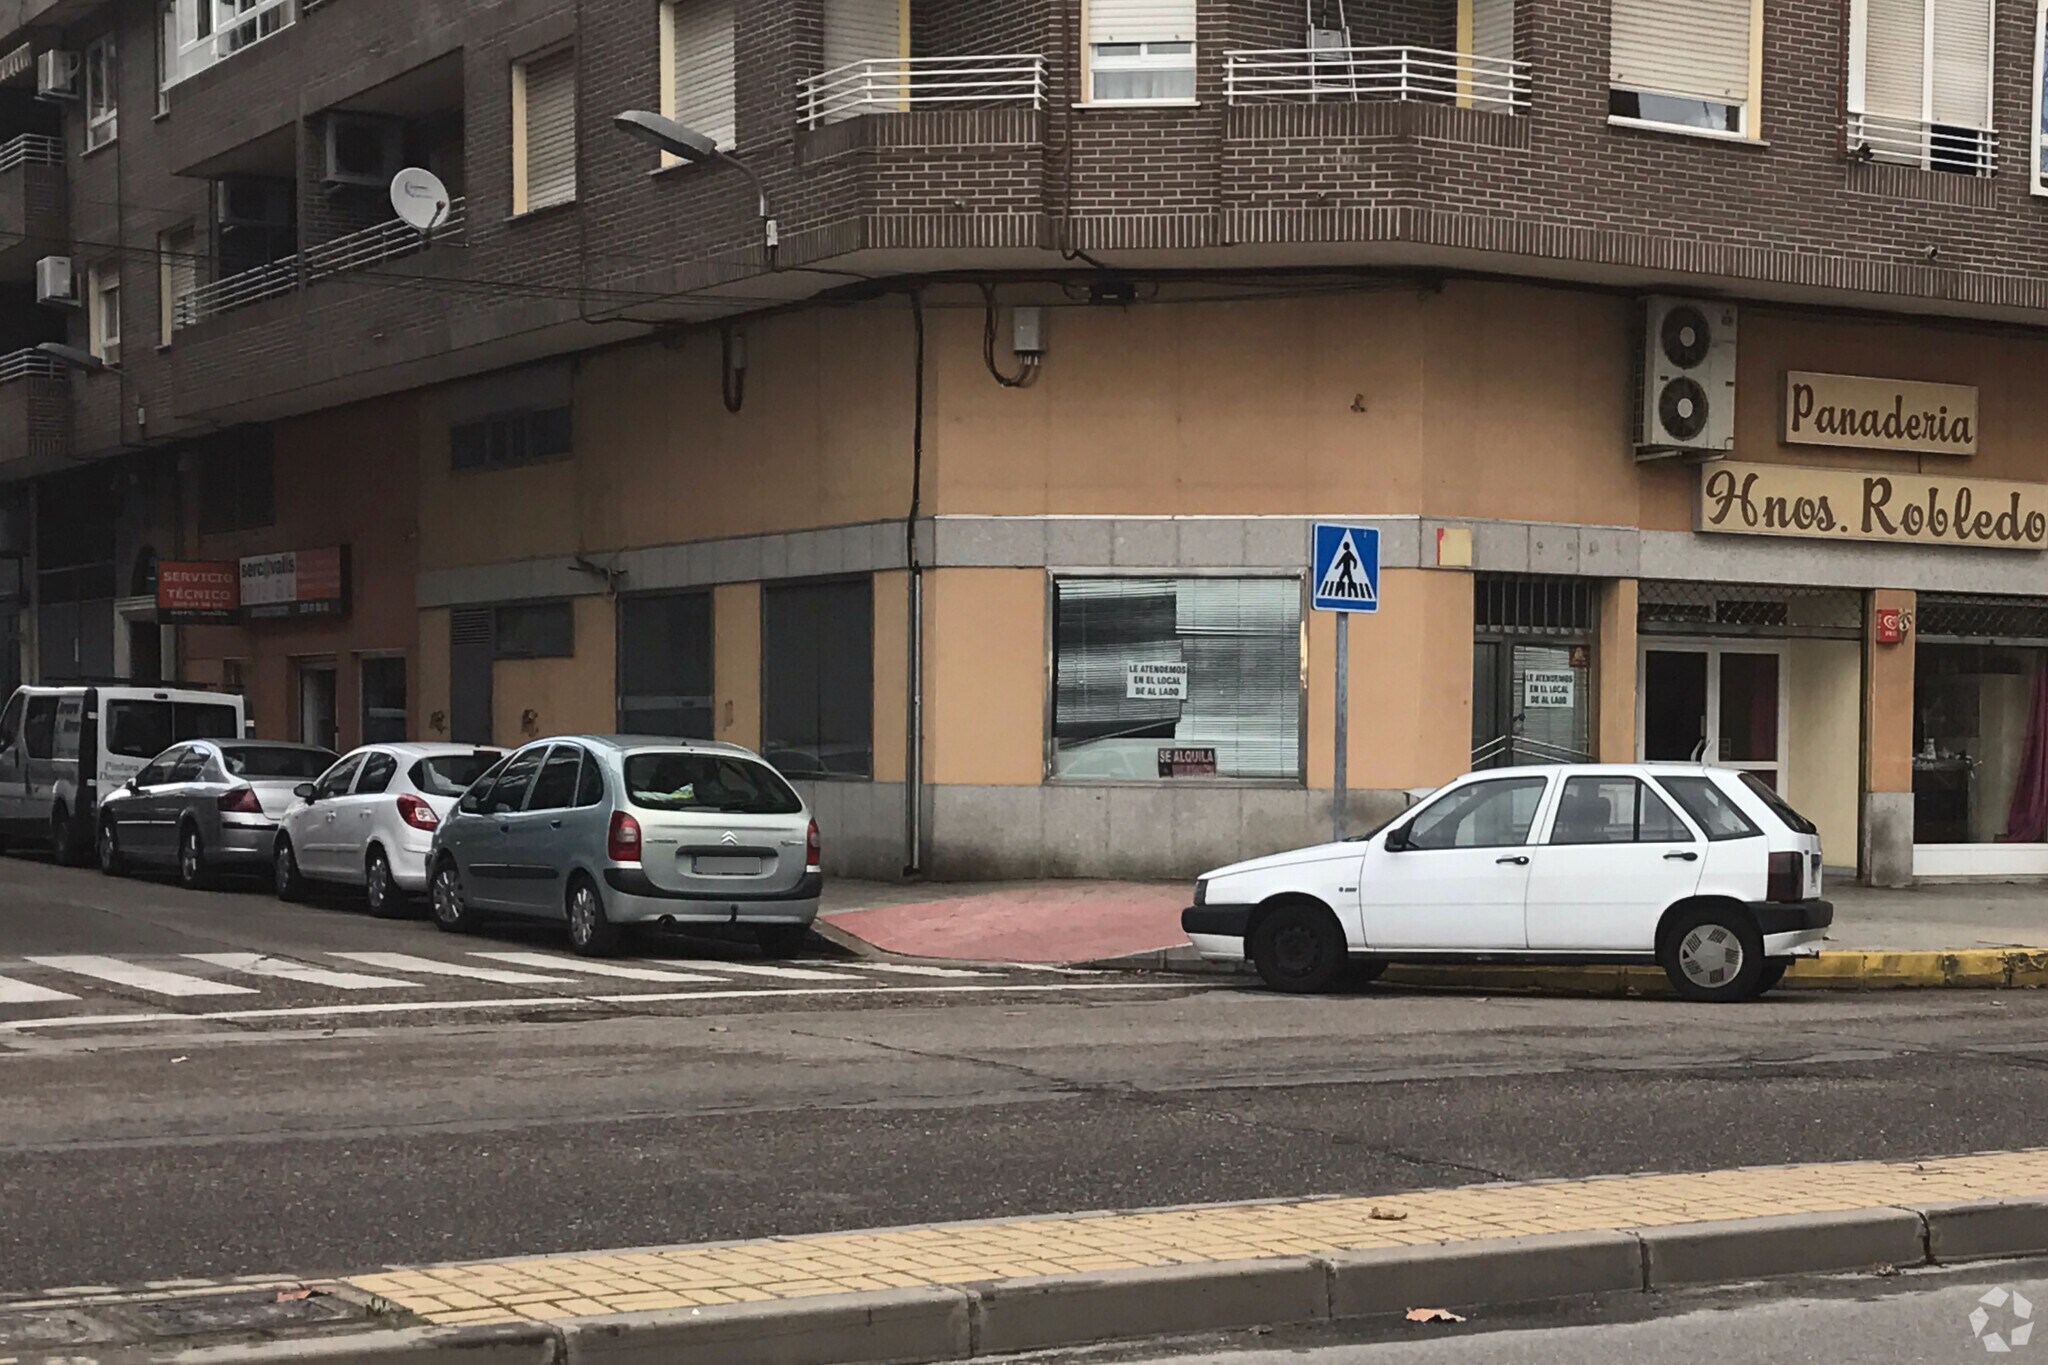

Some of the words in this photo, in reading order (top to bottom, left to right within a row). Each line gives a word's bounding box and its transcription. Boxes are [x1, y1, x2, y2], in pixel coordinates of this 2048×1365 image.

[1791, 383, 1974, 444] Panaderia
[1705, 470, 1848, 533] Hnos.
[1860, 477, 2047, 543] Robledo
[163, 571, 234, 583] SERVICIO
[166, 586, 231, 600] TÉCNICO
[1129, 665, 1139, 673] LE
[1140, 665, 1187, 674] ATENDEMOS
[1133, 676, 1144, 684] EN
[1146, 676, 1155, 684] EL
[1157, 677, 1181, 685] LOCAL
[1527, 674, 1534, 682] LE
[1536, 675, 1573, 683] ATENDEMOS
[1135, 687, 1145, 695] DE
[1147, 687, 1157, 695] AL
[1159, 688, 1179, 696] LADO
[1530, 685, 1539, 693] EN
[1540, 685, 1548, 693] EL
[1550, 685, 1569, 694] LOCAL
[1531, 696, 1540, 704] DE
[1541, 696, 1550, 704] AL
[1550, 696, 1567, 704] LADO
[1159, 750, 1171, 763] SE
[1173, 750, 1214, 763] ALQUILA
